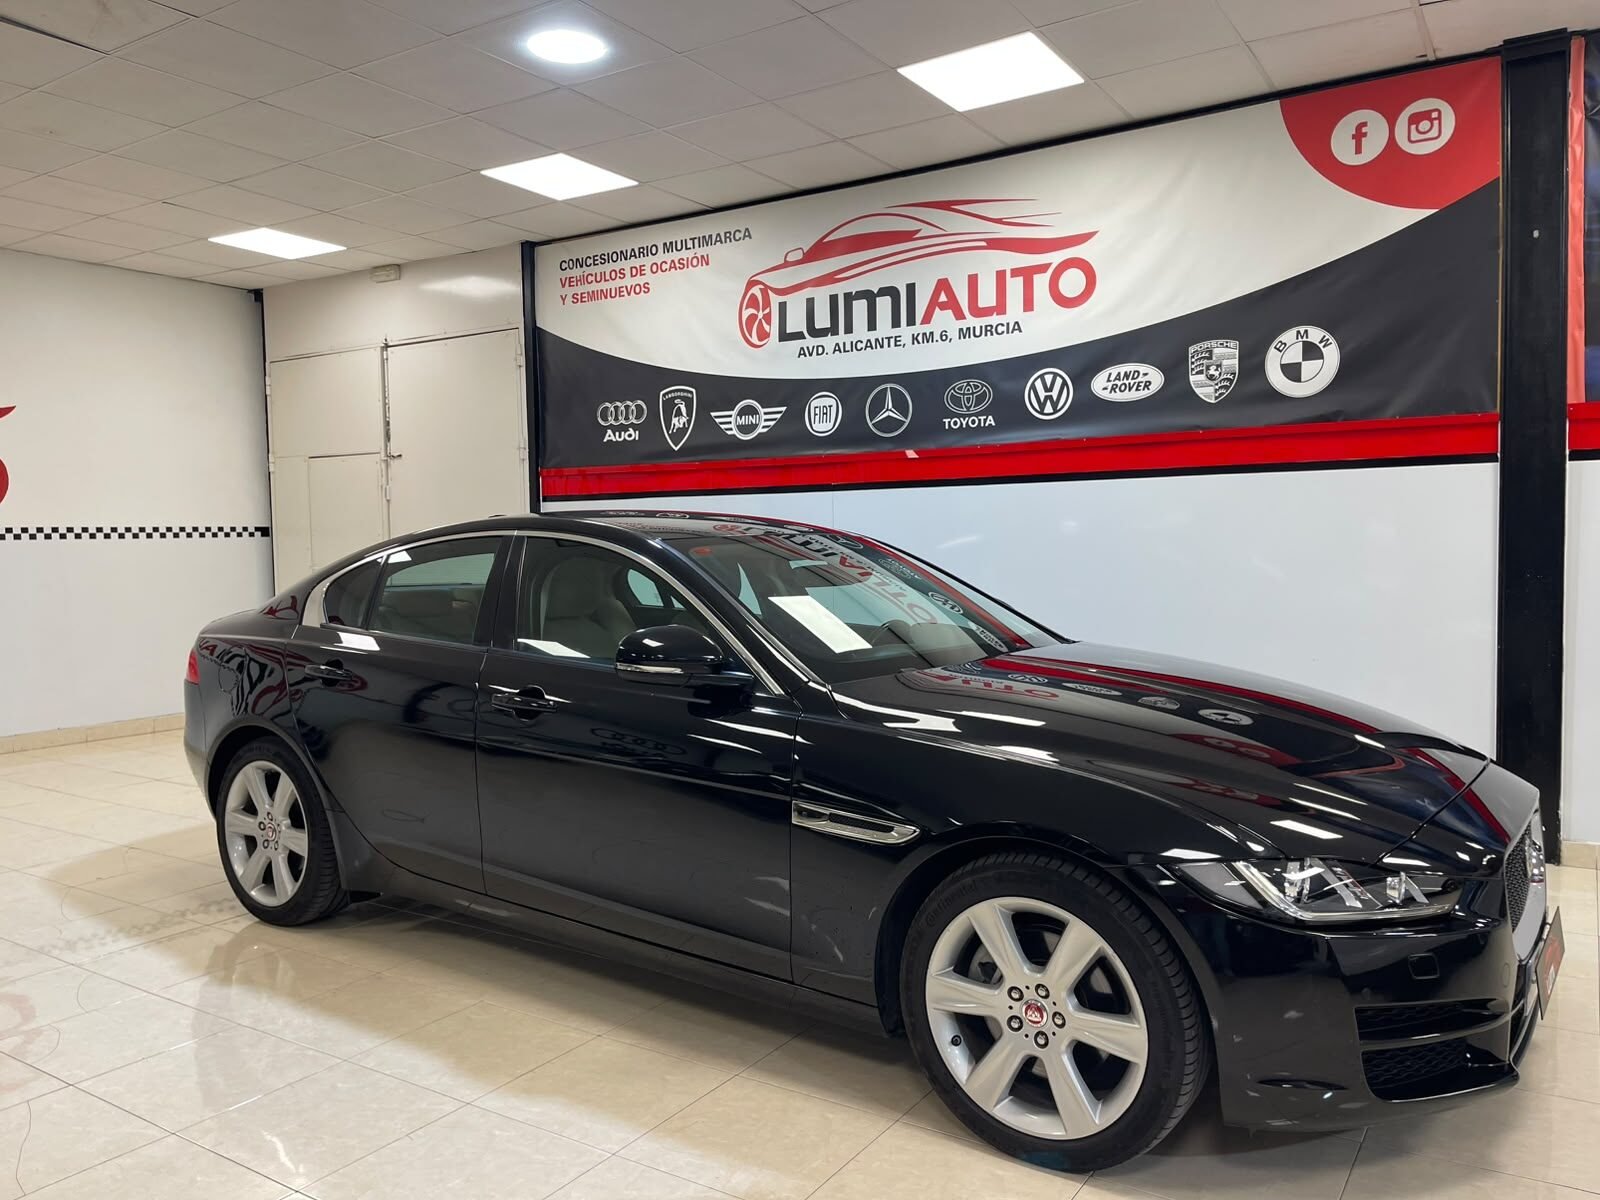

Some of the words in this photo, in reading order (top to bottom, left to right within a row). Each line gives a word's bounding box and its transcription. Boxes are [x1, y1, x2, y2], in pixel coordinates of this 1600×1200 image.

[560, 244, 658, 271] CONCESIONARIO
[662, 227, 752, 255] MULTIMARCA
[560, 267, 626, 289] VEHÍCULOS
[630, 264, 646, 280] DE
[650, 252, 710, 275] OCASIÓN
[560, 294, 568, 306] Y
[571, 282, 650, 305] SEMINUEVOS
[797, 345, 829, 359] AVD.
[832, 335, 906, 355] ALICANTE,
[911, 330, 953, 346] KM.6,
[958, 321, 1023, 341] MURCIA
[1190, 340, 1238, 351] PORSCHE
[1274, 329, 1333, 353] BMW
[736, 414, 759, 426] MINI
[814, 403, 833, 425] FIAT
[943, 415, 995, 429] TOYOTA
[603, 427, 640, 442] Audi
